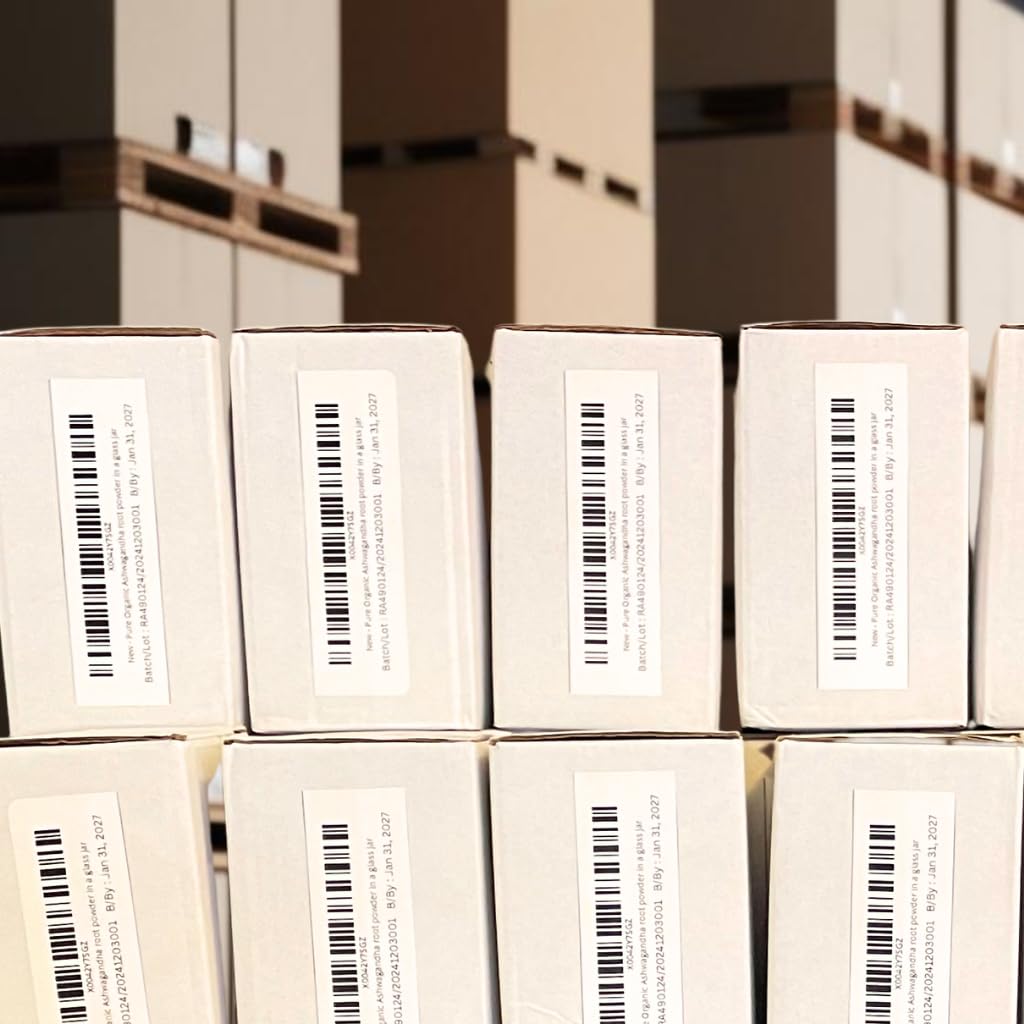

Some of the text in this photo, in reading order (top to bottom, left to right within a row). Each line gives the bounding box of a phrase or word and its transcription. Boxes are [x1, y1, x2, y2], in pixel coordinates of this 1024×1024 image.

[883, 387, 893, 412] 2027
[122, 403, 133, 428] 2027
[885, 431, 893, 449] Jan
[127, 446, 136, 465] Jan
[884, 456, 895, 480] B/By
[128, 472, 139, 496] B/By
[885, 618, 894, 666] Batch/Lot
[141, 634, 153, 683] Batch/Lot
[380, 811, 391, 837] 2027
[927, 814, 937, 840] 2027
[384, 857, 393, 876] Jan
[927, 860, 936, 879] Jan
[385, 884, 397, 909] B/By
[925, 887, 938, 912] B/By
